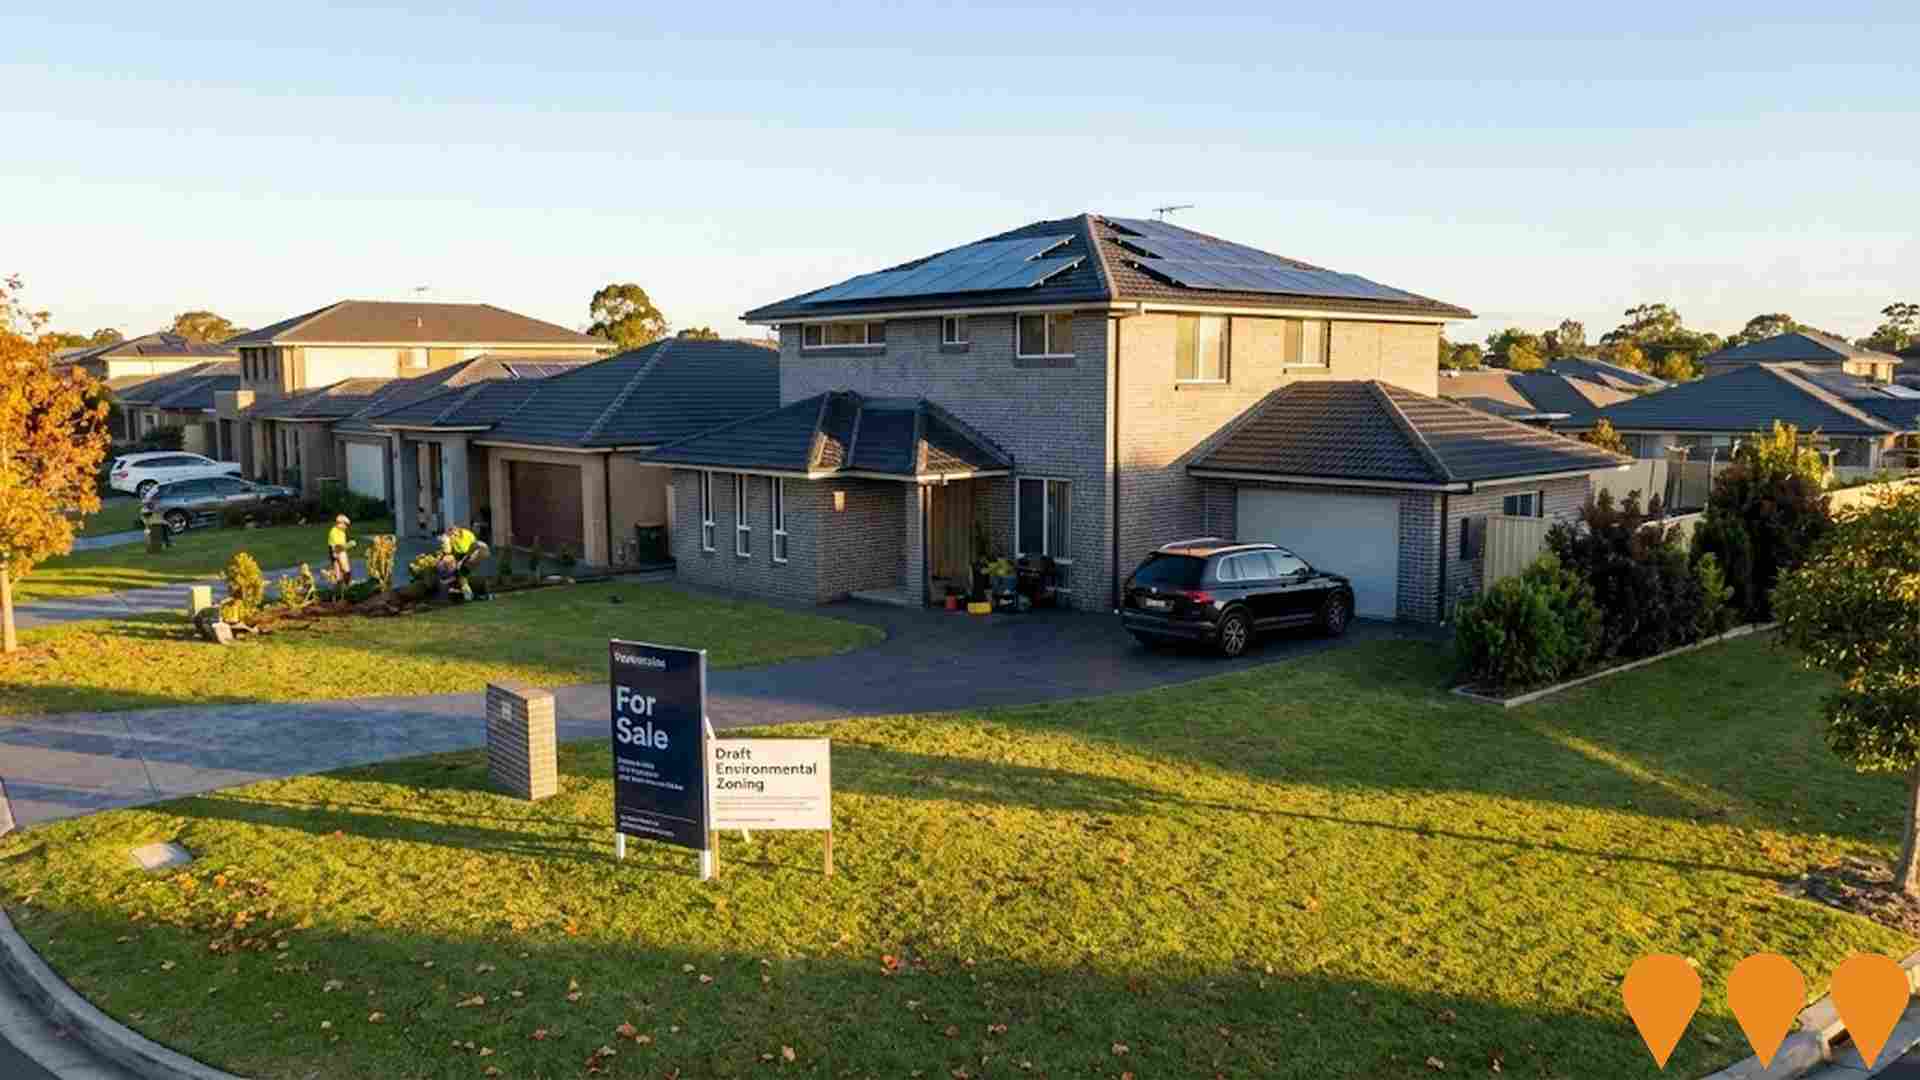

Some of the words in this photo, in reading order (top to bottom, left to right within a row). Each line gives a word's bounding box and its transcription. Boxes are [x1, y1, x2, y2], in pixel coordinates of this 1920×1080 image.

[616, 686, 657, 717] For
[616, 718, 669, 750] Sale
[715, 747, 752, 760] Draft
[715, 762, 817, 776] Environmental
[716, 778, 765, 792] Zoning
